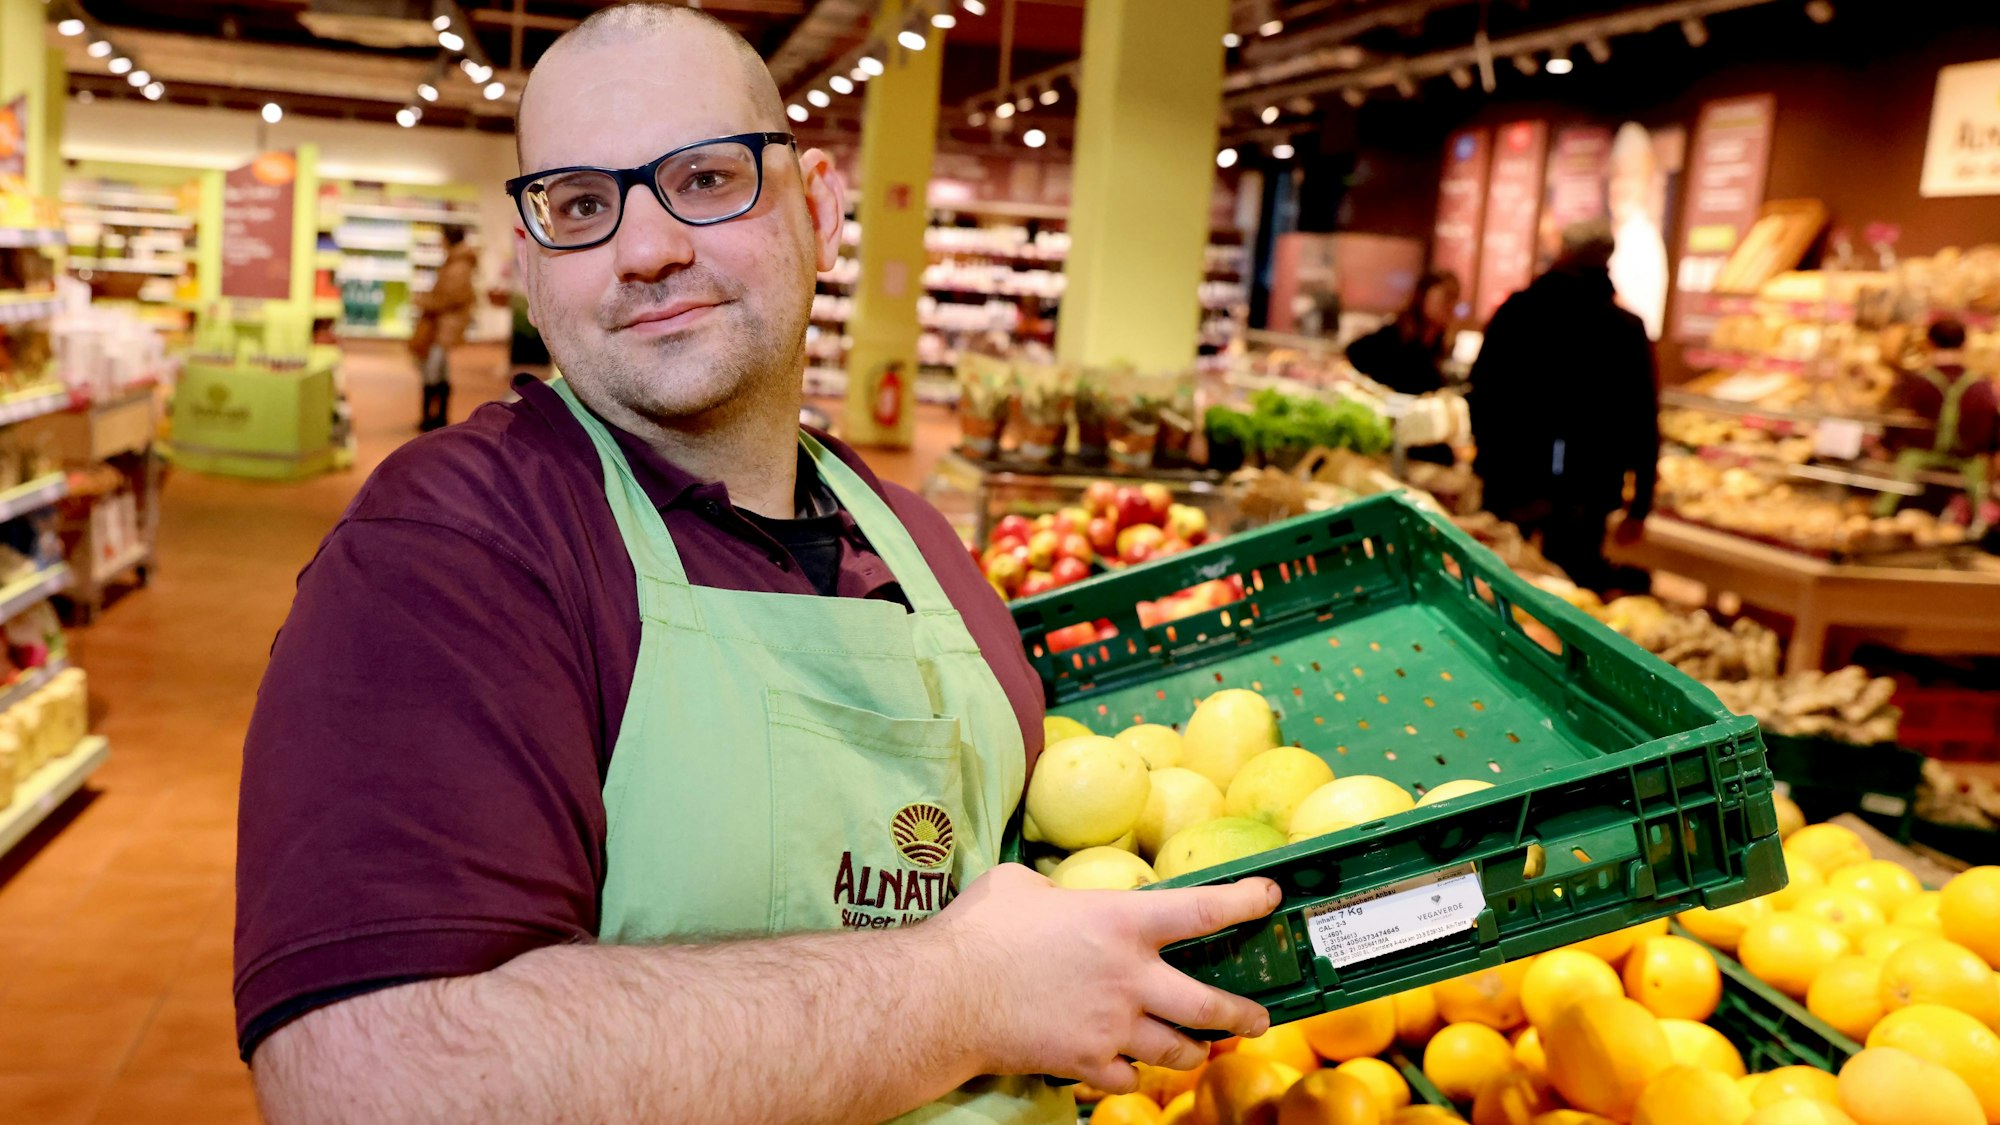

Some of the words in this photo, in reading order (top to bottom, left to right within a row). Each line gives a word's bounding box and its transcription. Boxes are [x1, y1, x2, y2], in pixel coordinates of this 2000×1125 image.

[1375, 889, 1396, 899] Anbau
[842, 908, 896, 931] super
[1348, 906, 1363, 918] Kg
[1418, 903, 1463, 921] VEGAVERDE
[1319, 924, 1334, 932] CAL:
[1325, 943, 1345, 952] GGN:
[1347, 926, 1400, 946] 4050373474645
